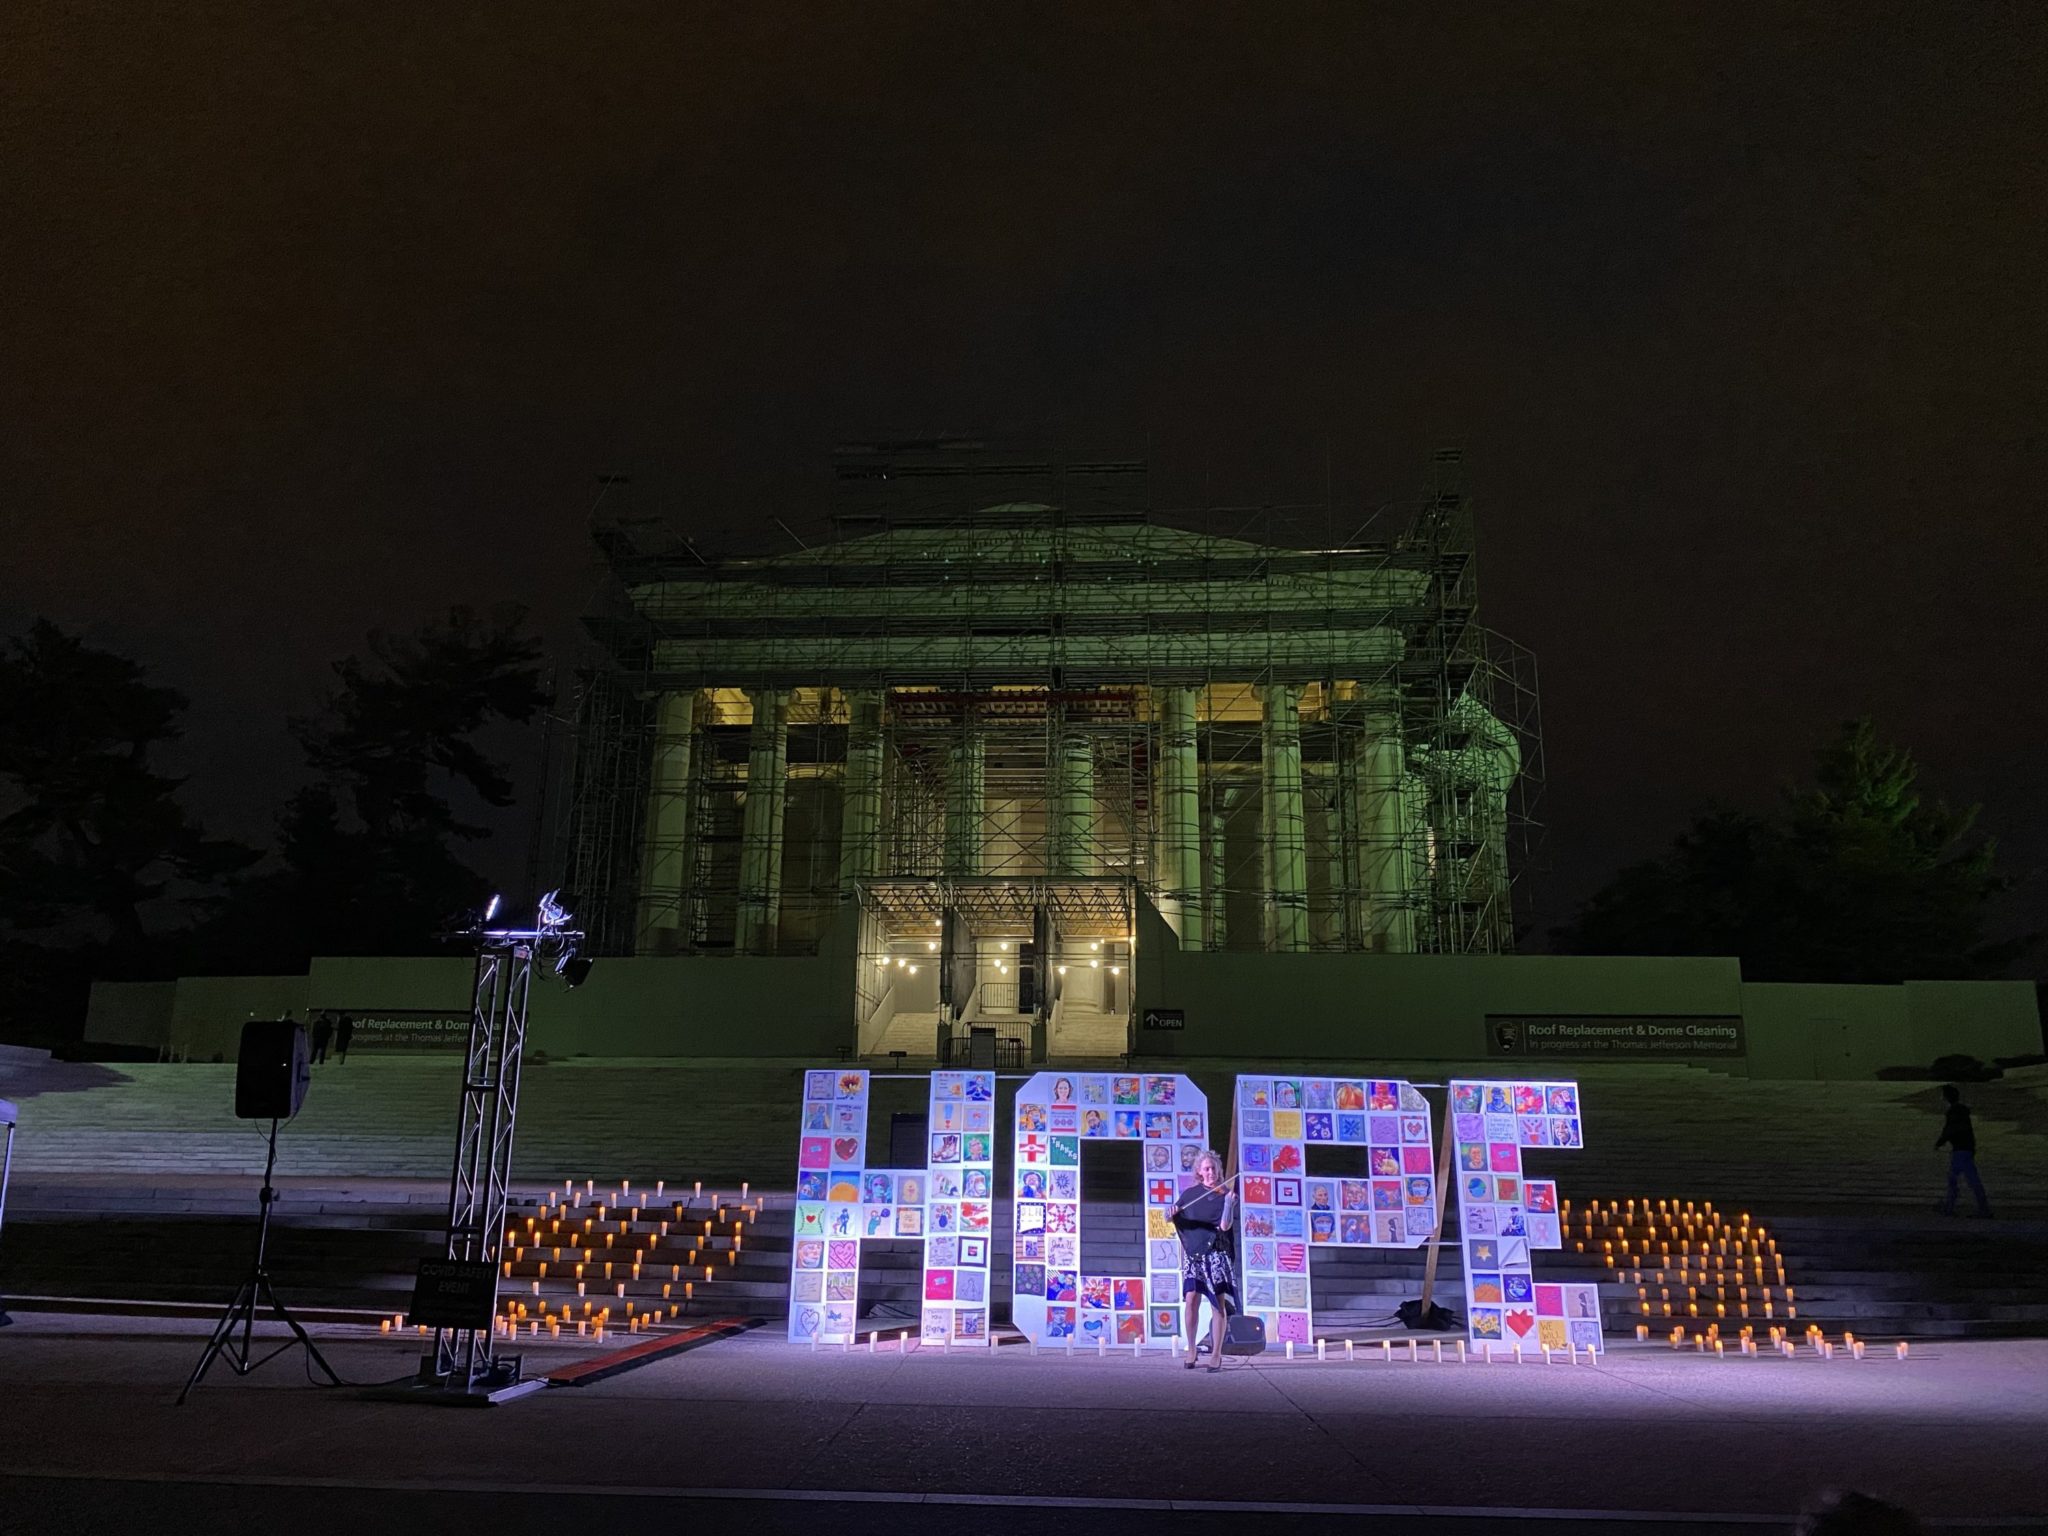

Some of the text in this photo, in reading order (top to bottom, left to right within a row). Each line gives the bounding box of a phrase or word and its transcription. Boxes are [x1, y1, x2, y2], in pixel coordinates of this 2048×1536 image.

[352, 1018, 366, 1029] of
[368, 1018, 433, 1031] Replacement
[434, 1020, 443, 1030] &
[445, 1020, 470, 1030] Dom
[1159, 1019, 1183, 1027] OPEN
[1528, 1024, 1737, 1038] Roof Replacement & Dome Cleaning
[1529, 1040, 1738, 1051] In progress at the Thomas Jefferson Memorial
[420, 1264, 456, 1277] COVID
